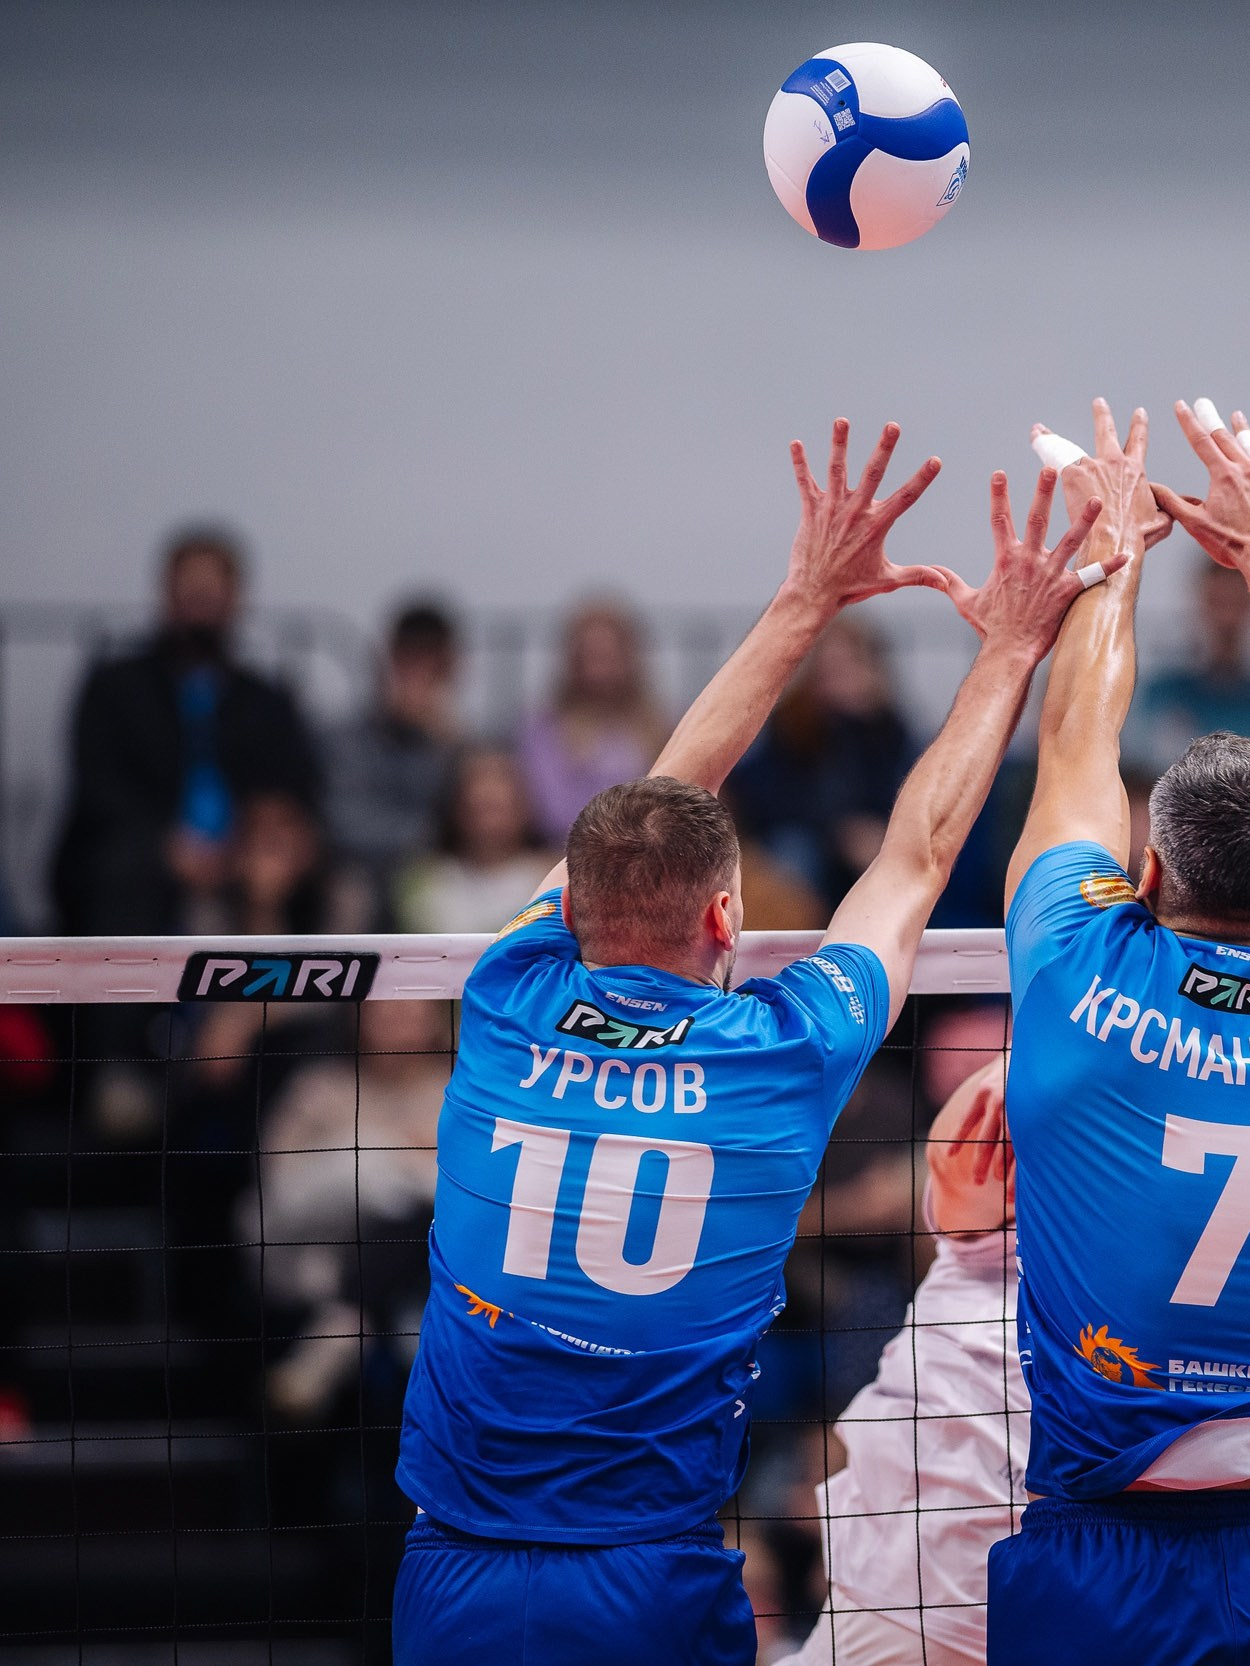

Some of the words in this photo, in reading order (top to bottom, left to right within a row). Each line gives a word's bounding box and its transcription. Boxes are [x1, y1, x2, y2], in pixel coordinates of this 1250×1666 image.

[196, 958, 361, 997] PARI
[604, 991, 668, 1012] ENSEN
[519, 1042, 708, 1115] УРСОВ
[490, 1116, 715, 1297] 10
